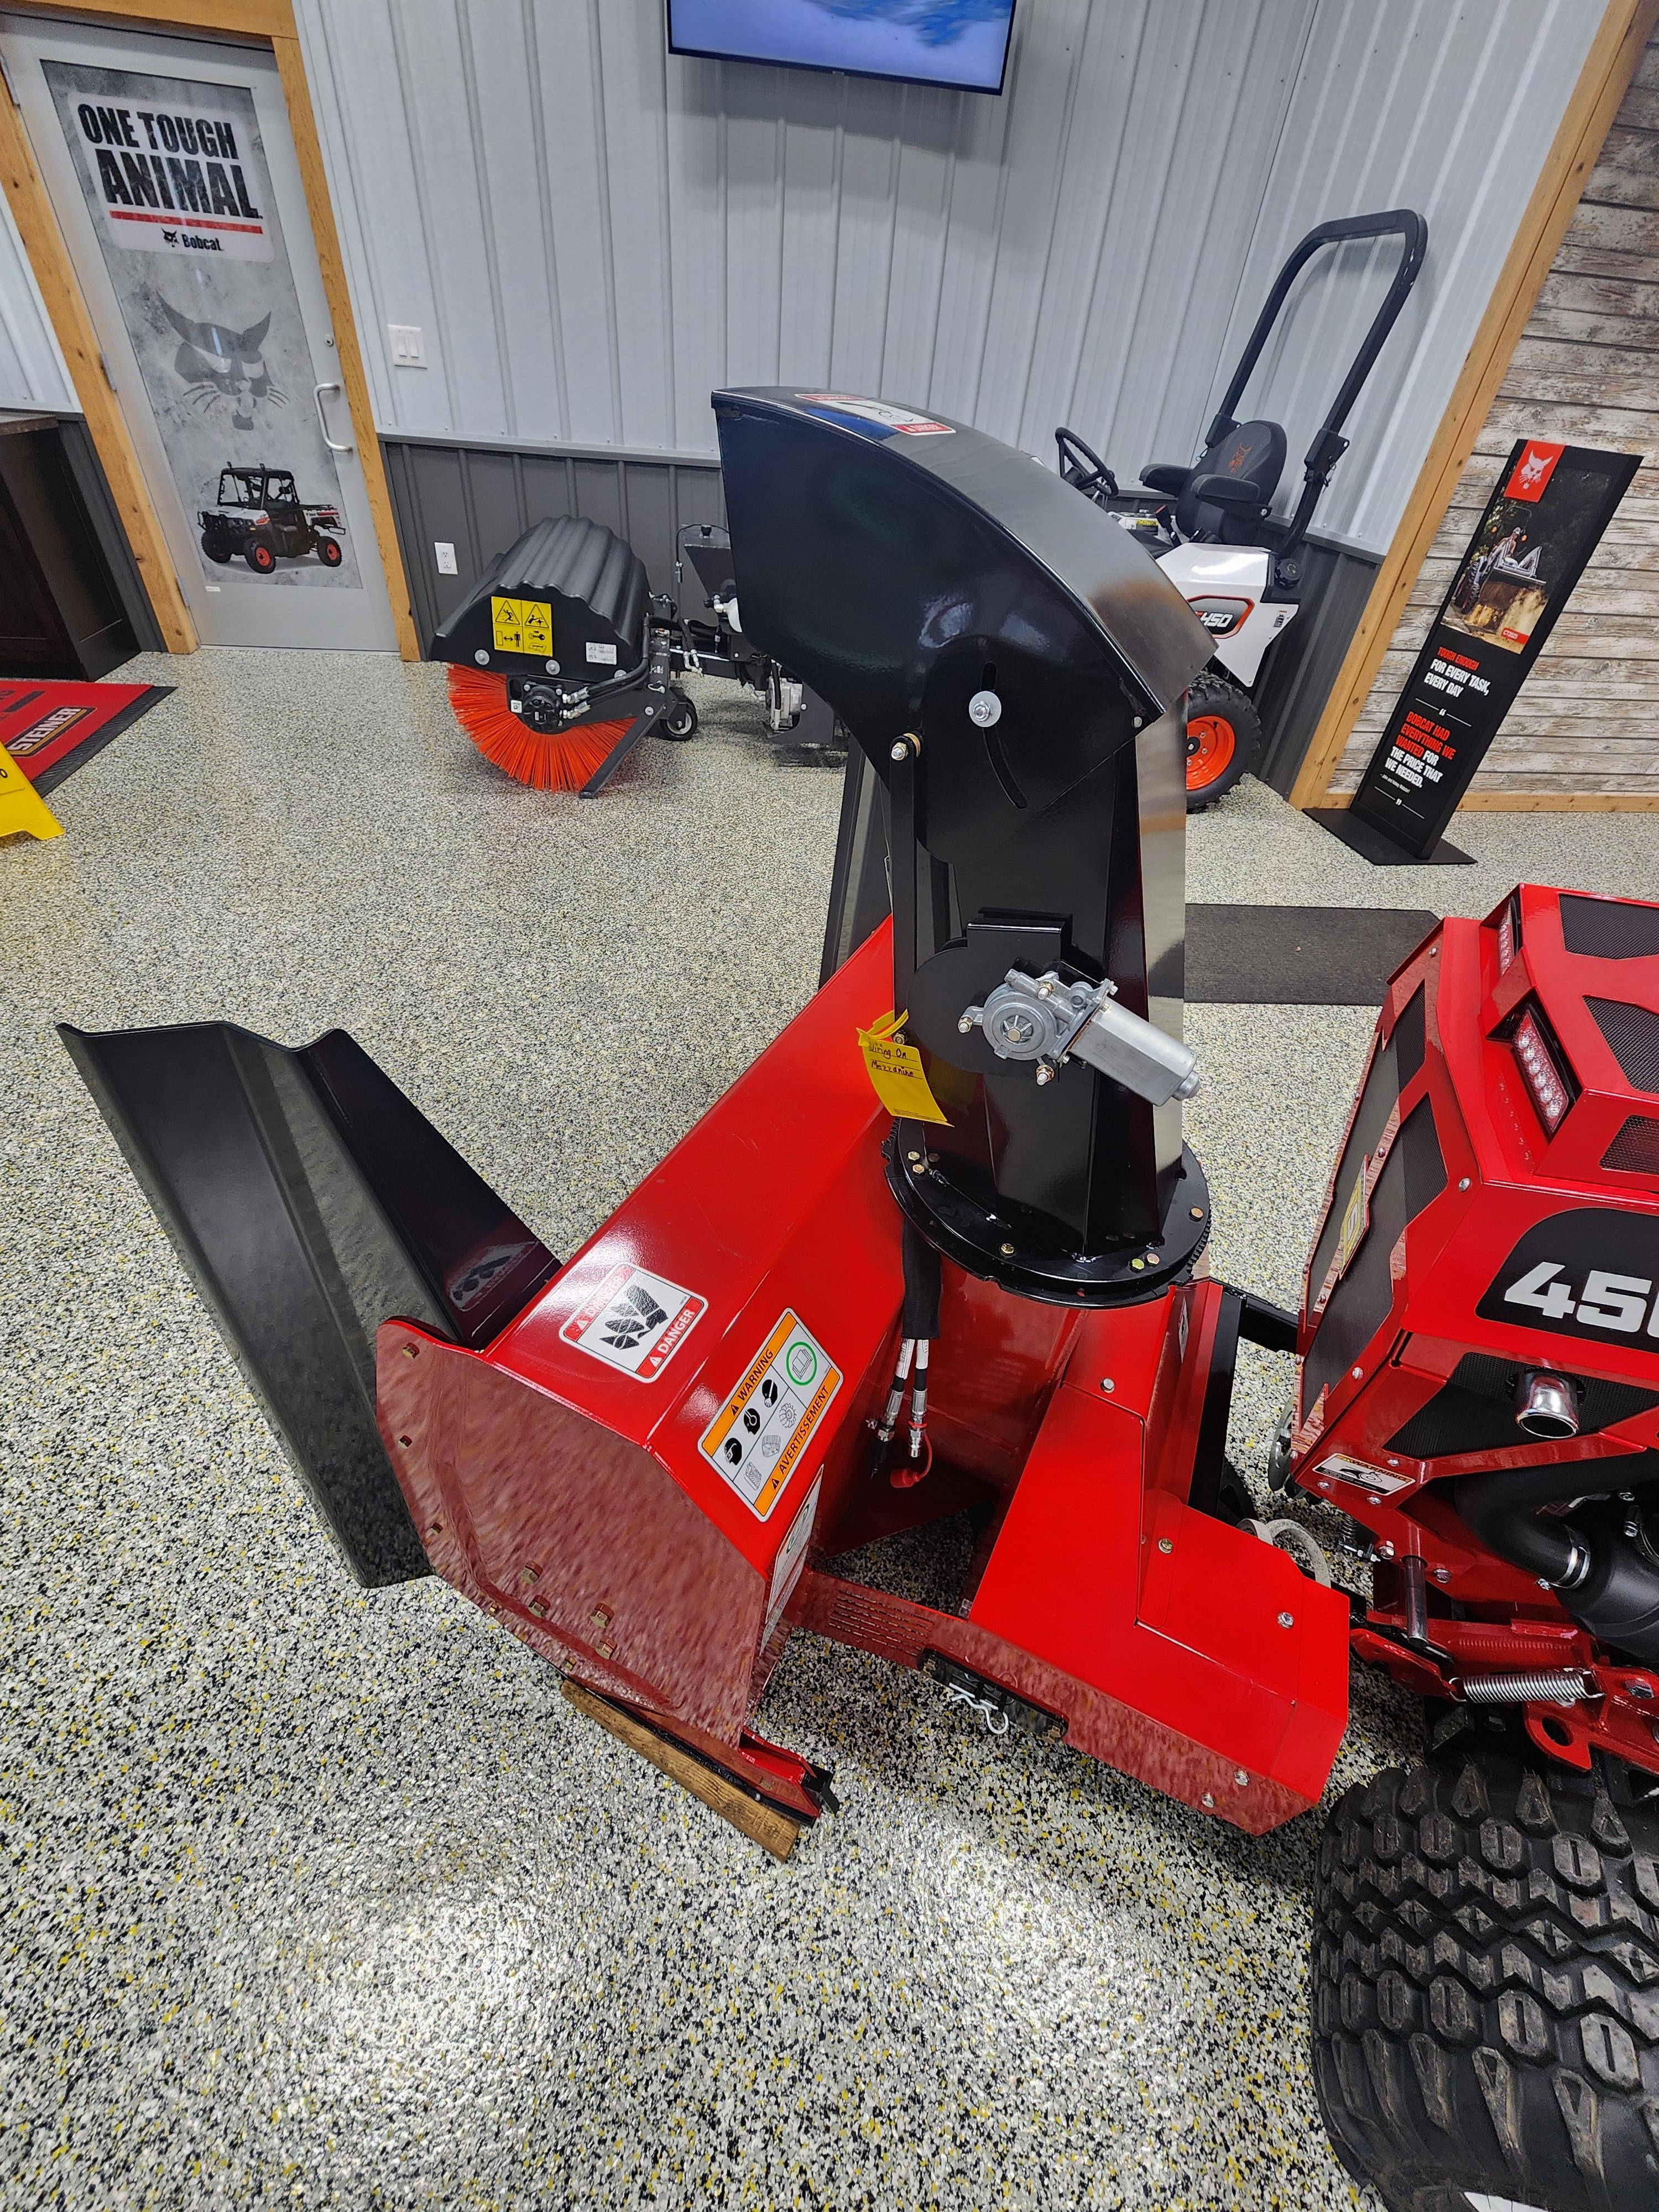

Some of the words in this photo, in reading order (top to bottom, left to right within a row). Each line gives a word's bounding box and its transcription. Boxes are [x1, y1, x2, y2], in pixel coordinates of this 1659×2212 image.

[77, 103, 140, 148] ONE
[137, 111, 239, 159] TOUGH
[181, 234, 222, 251] Bobcat
[1437, 646, 1457, 661] TOUGH
[1455, 654, 1479, 671] ENOUGH
[1424, 672, 1449, 691] EVERY
[1446, 682, 1464, 697] DAY
[1430, 659, 1447, 673] FOR
[1444, 665, 1471, 684] EVERY
[1468, 675, 1491, 696] TASK,
[7, 708, 82, 750] STEINER
[1401, 723, 1443, 753] EVERYTHING
[1442, 745, 1456, 760] WE
[1406, 711, 1435, 733] BOBCAT
[1432, 725, 1450, 741] HAD
[1390, 746, 1405, 761] THE
[1402, 753, 1425, 773] PRICE
[1423, 765, 1443, 782] THAT
[1396, 734, 1425, 758] WANTED
[1422, 750, 1439, 766] FOR
[1385, 758, 1398, 771] WE
[1395, 764, 1423, 788] NEEDED.
[872, 1060, 914, 1077] Mezzanine
[896, 1048, 907, 1059] On
[1504, 1261, 1659, 1338] 45
[657, 1309, 695, 1354] DANGER
[738, 1349, 773, 1401] WARNING
[779, 1385, 829, 1474] AVERTISSEMENT
